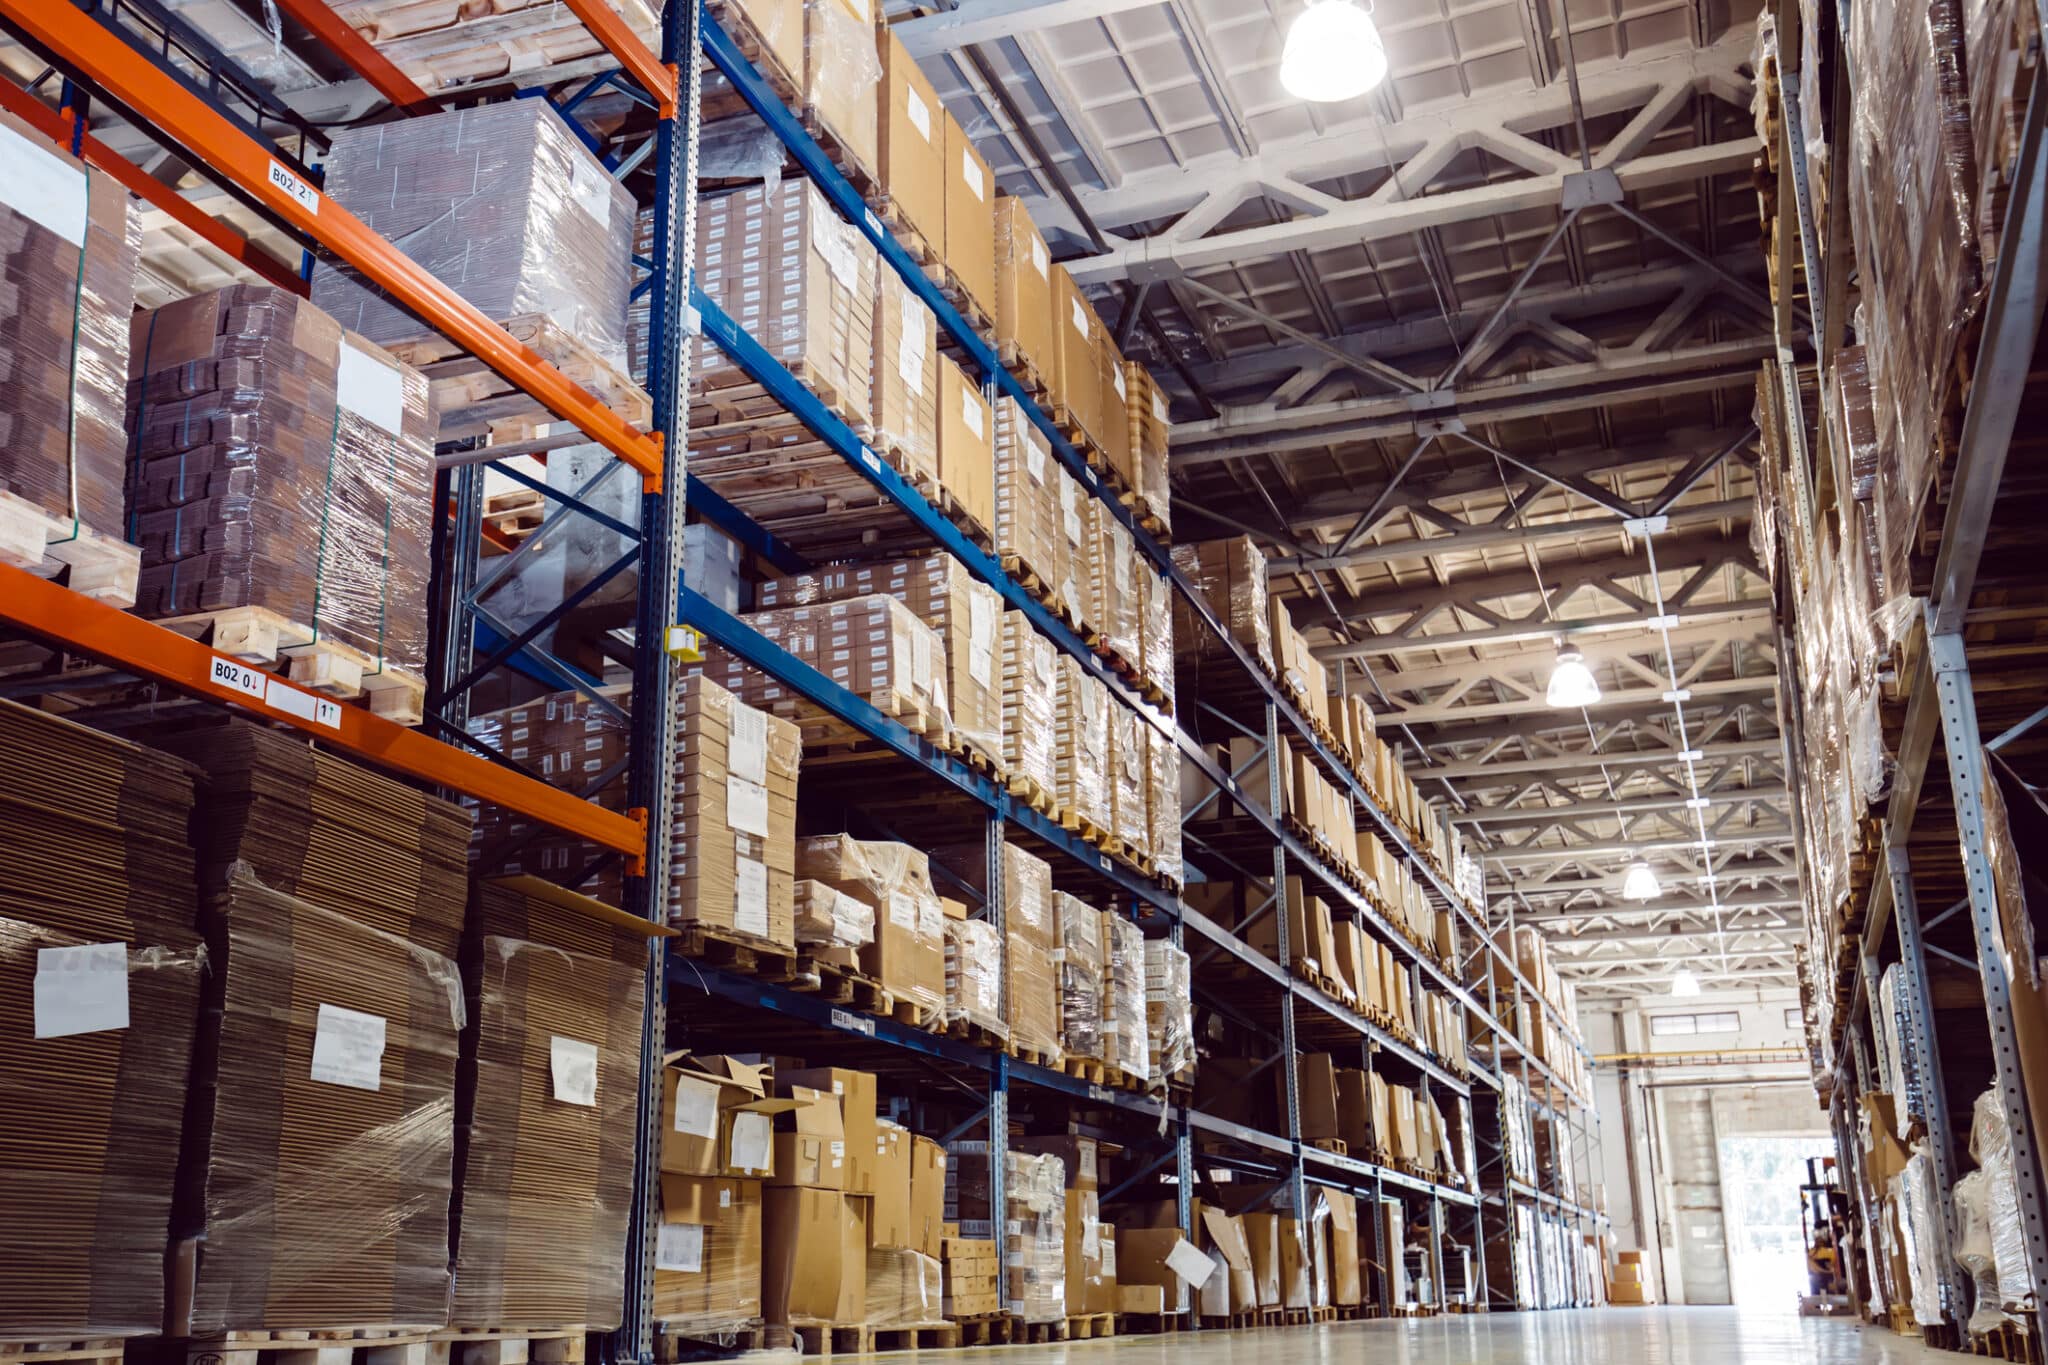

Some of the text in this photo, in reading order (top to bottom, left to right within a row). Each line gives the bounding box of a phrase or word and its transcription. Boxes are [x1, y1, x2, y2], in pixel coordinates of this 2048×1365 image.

[273, 168, 306, 199] B02 2
[215, 662, 250, 688] B02 0
[321, 704, 327, 717] 1
